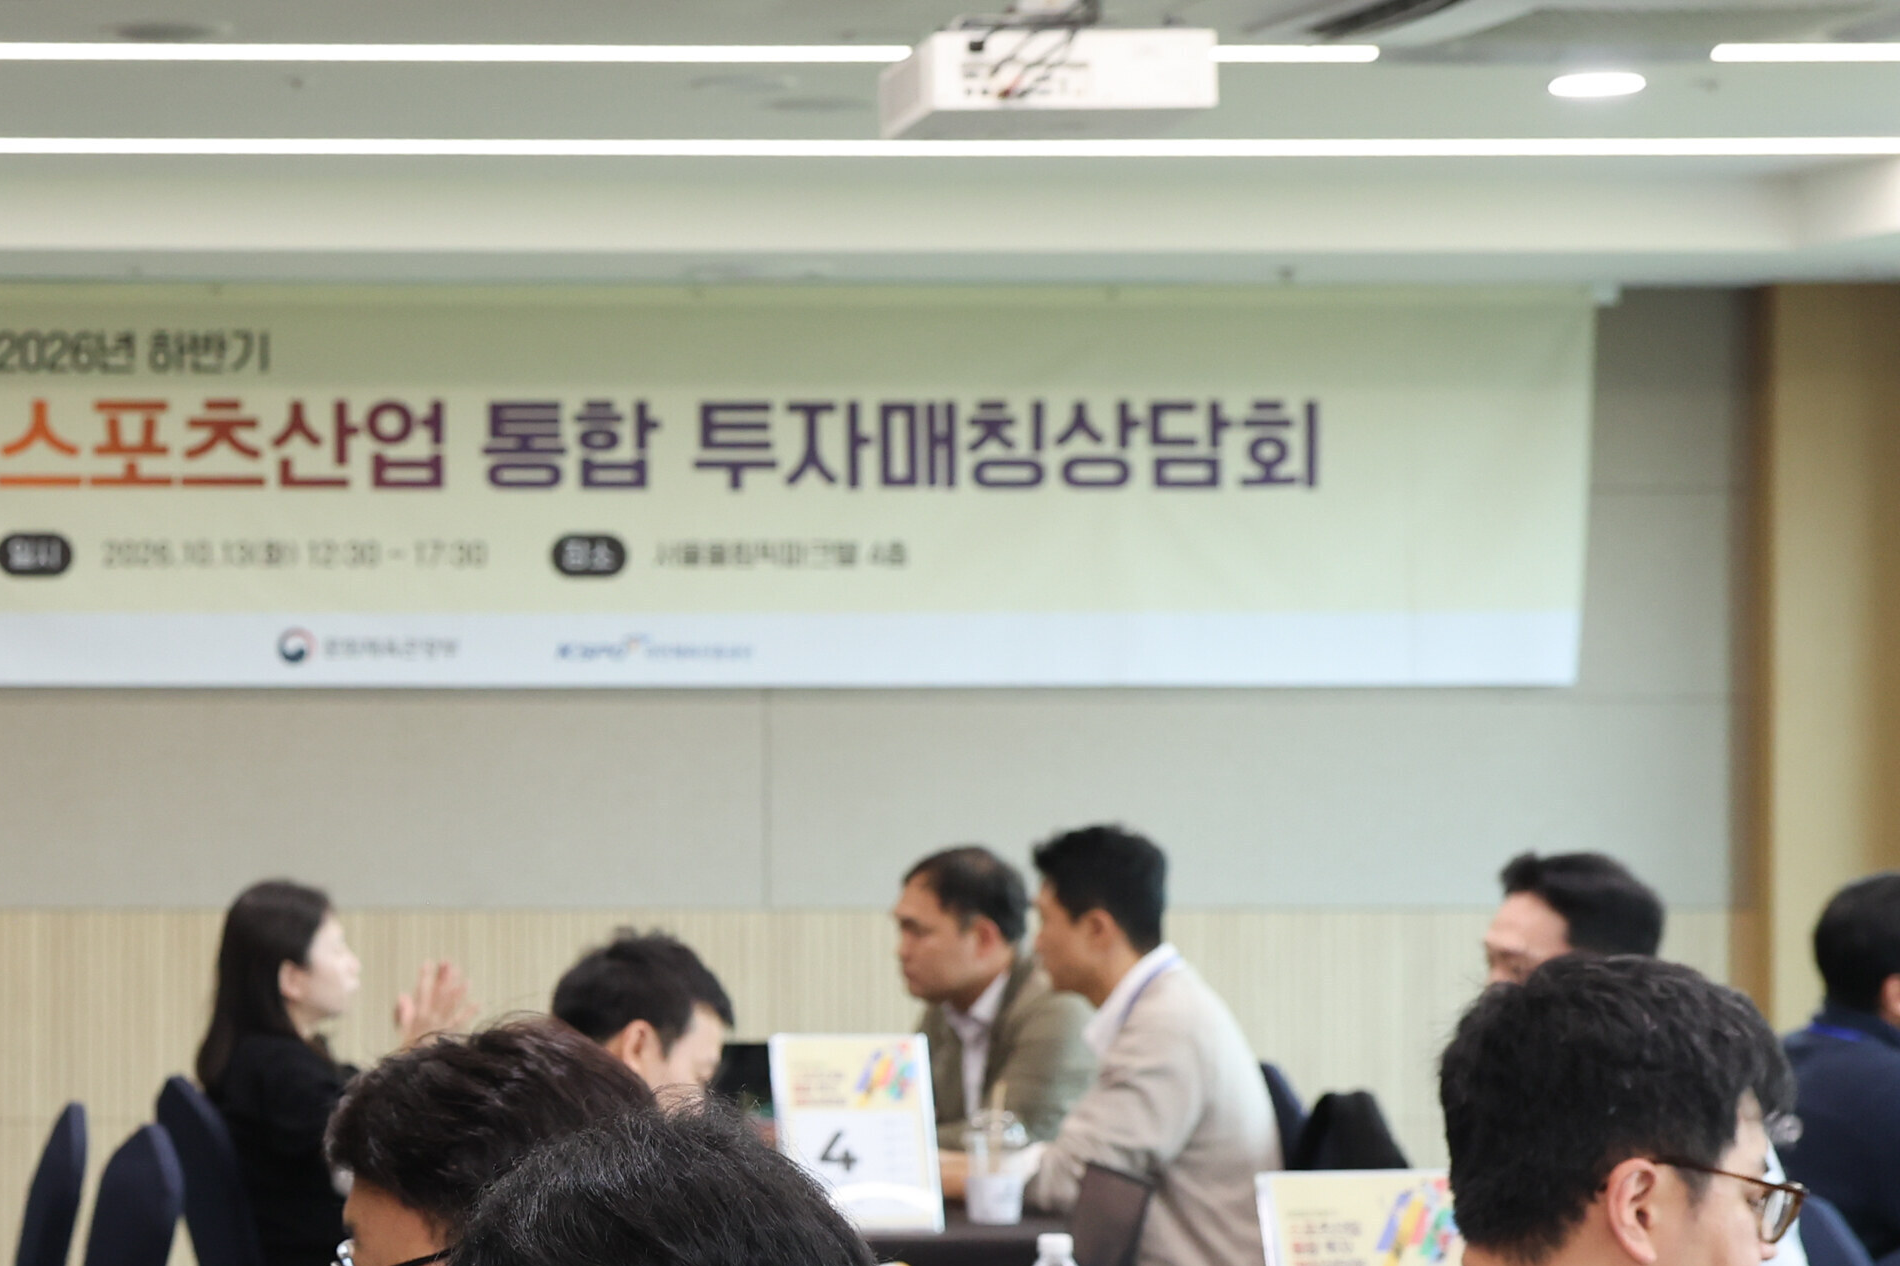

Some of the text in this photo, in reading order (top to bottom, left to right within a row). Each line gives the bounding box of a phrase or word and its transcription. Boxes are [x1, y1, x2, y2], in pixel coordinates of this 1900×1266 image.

[147, 329, 271, 374] 하반기
[482, 398, 660, 491] 통합
[693, 397, 1321, 492] 투자매칭상담회
[819, 1130, 858, 1172] 4
